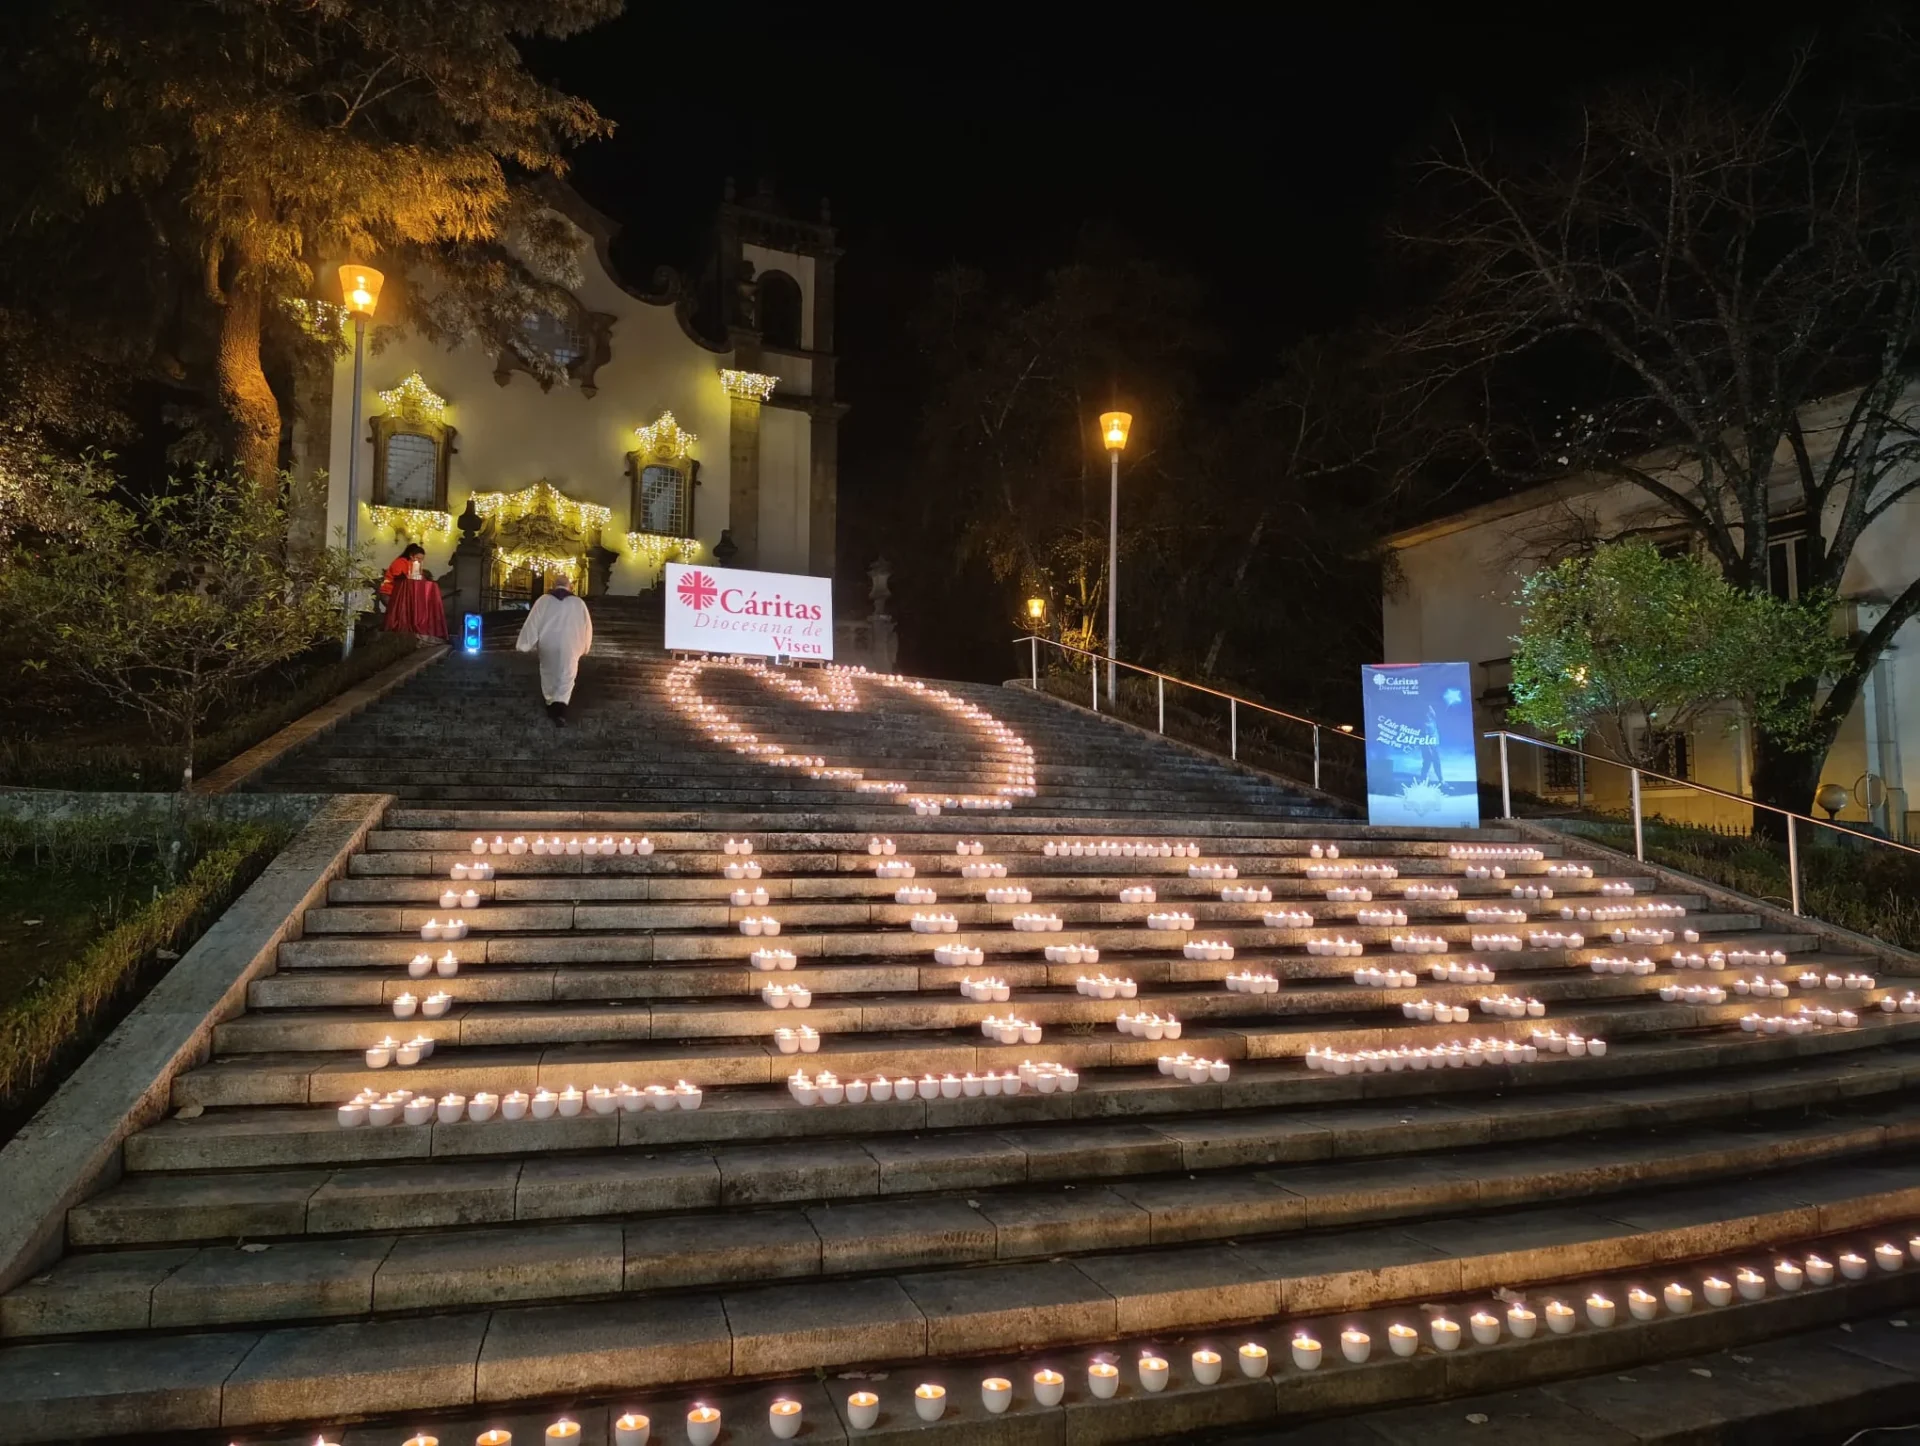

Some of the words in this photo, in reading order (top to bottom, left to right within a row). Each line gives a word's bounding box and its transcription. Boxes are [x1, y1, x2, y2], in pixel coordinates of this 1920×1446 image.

[720, 589, 822, 621] Cáritas
[694, 613, 793, 634] Diocesana
[802, 621, 823, 637] de
[772, 636, 822, 654] Viseu
[1386, 677, 1419, 686] Cáritas
[1396, 732, 1437, 745] Estrela
